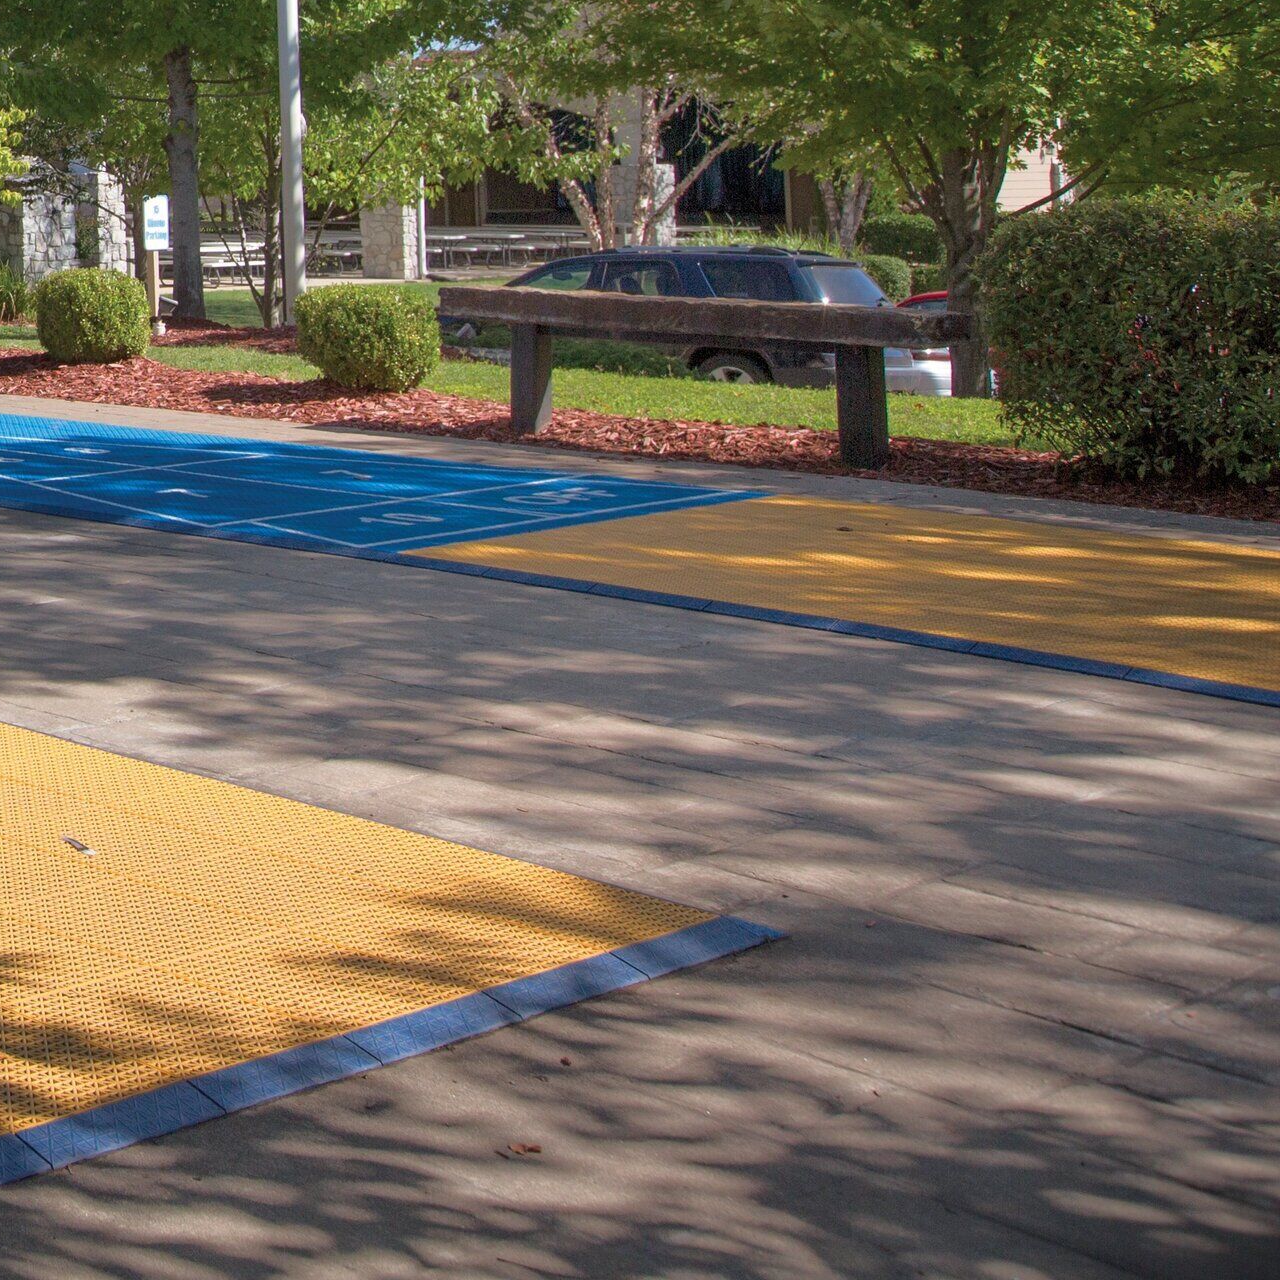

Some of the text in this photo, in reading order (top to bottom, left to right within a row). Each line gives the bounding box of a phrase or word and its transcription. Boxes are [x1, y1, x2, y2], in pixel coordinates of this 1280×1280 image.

[318, 469, 374, 480] 7
[155, 487, 210, 499] 7
[502, 486, 619, 506] OFF
[360, 512, 445, 526] 10
